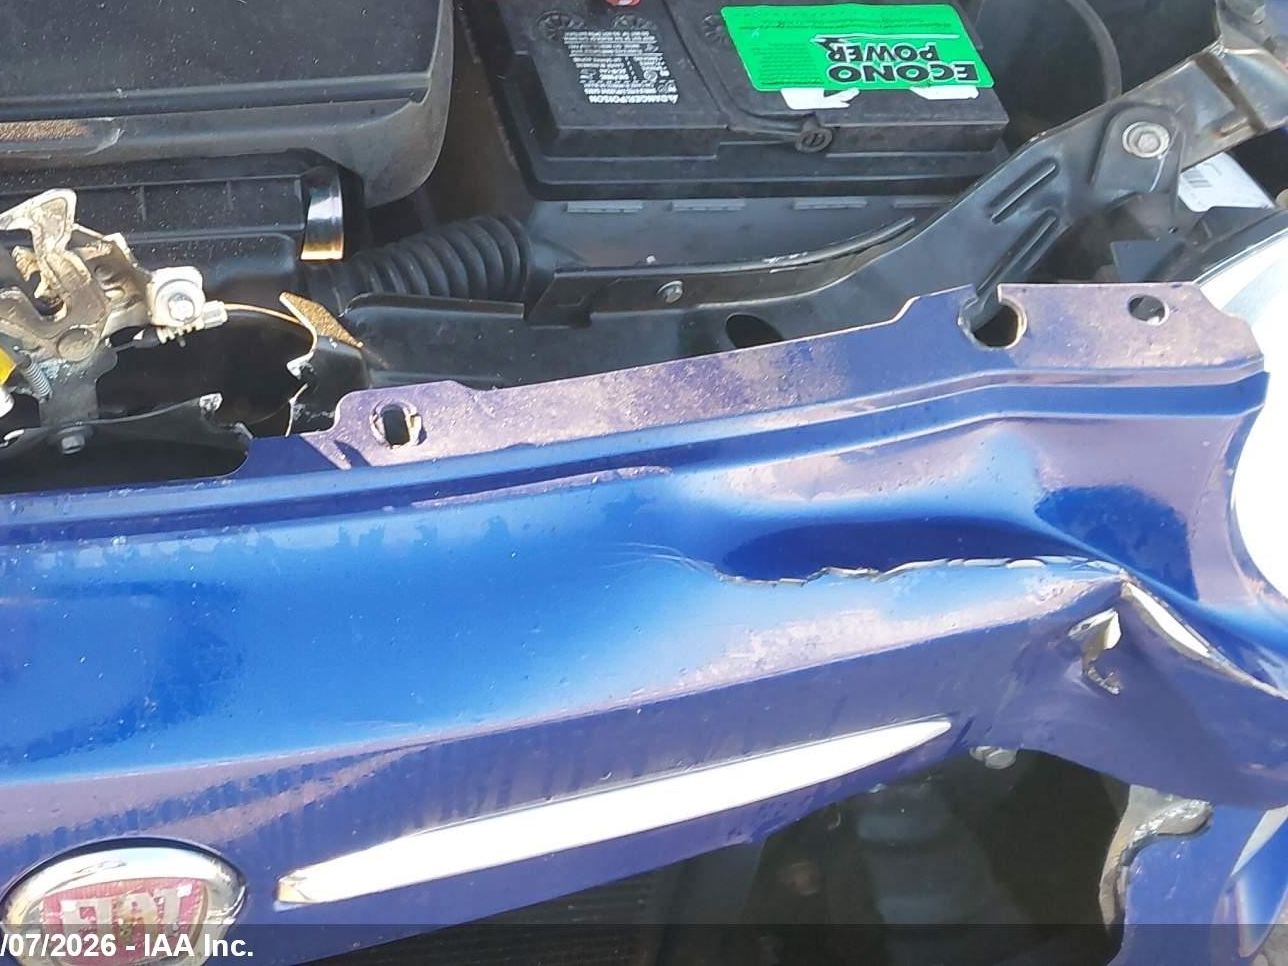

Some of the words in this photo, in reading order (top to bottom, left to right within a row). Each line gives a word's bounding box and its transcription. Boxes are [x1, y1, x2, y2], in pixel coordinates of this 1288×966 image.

[824, 38, 940, 63] POWER
[826, 61, 980, 83] ECONO
[59, 884, 194, 940] FIAT
